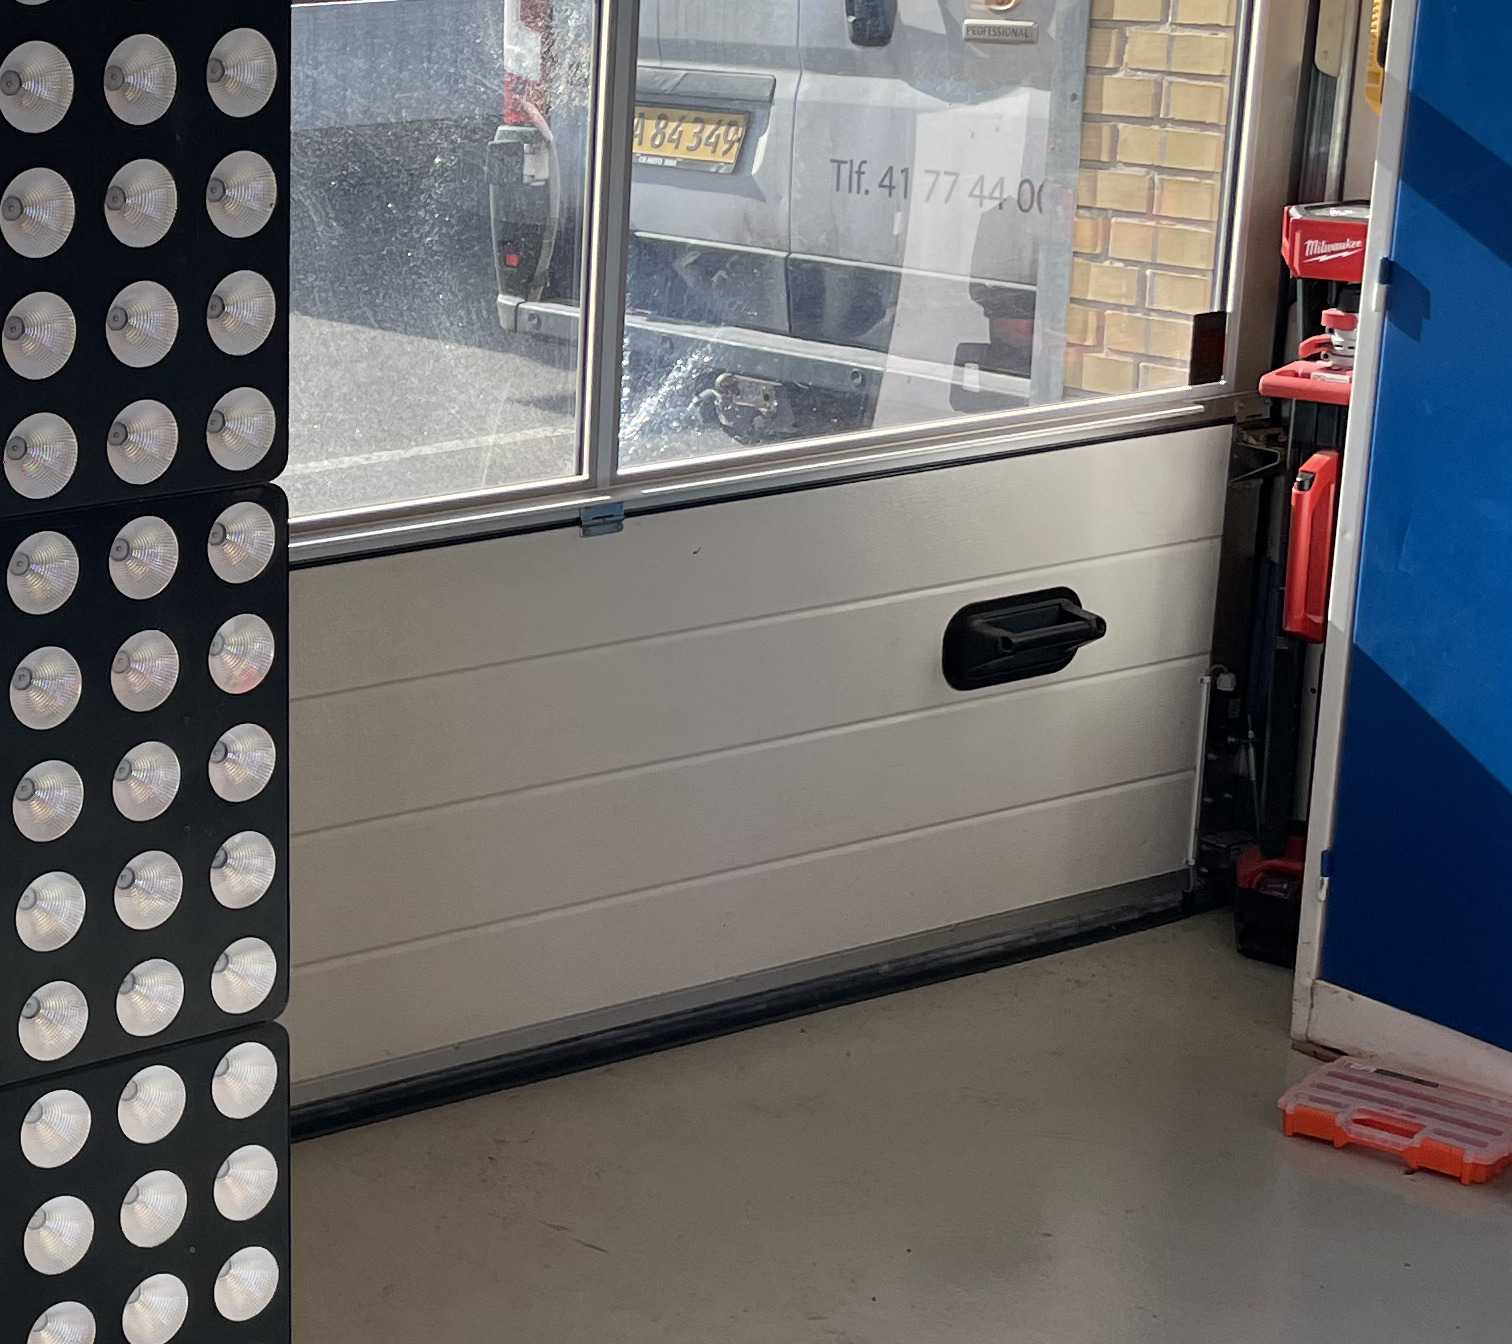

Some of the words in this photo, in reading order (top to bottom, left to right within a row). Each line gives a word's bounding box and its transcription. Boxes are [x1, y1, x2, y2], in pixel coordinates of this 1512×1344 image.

[967, 26, 1030, 39] PROFESSIONAL
[830, 158, 870, 196] Tlf.
[878, 166, 909, 200] 41
[924, 169, 960, 205] 77
[968, 175, 1007, 210] 44
[1304, 238, 1363, 256] Milwaukee
